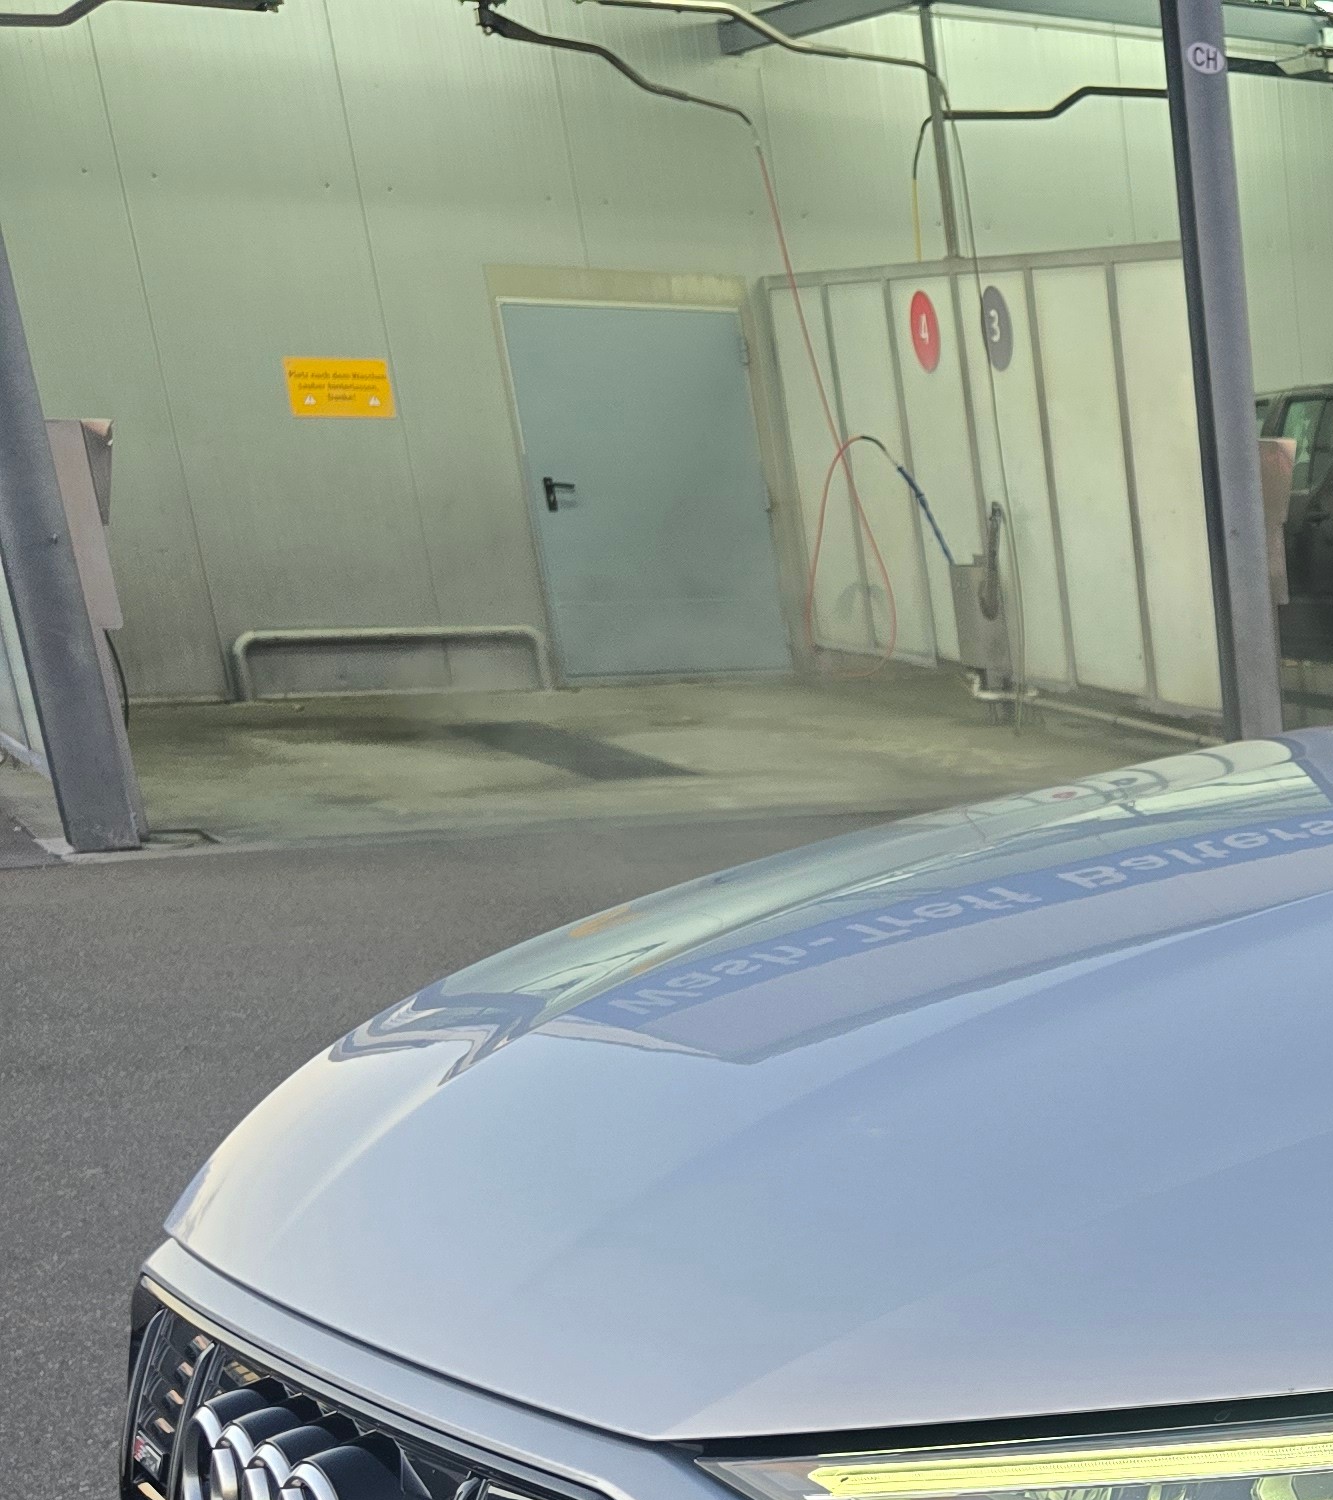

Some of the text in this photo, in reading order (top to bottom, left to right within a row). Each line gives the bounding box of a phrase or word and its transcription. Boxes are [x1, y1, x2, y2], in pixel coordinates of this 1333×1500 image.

[1192, 46, 1218, 71] CH
[919, 313, 930, 345] 4
[989, 308, 1001, 343] 3
